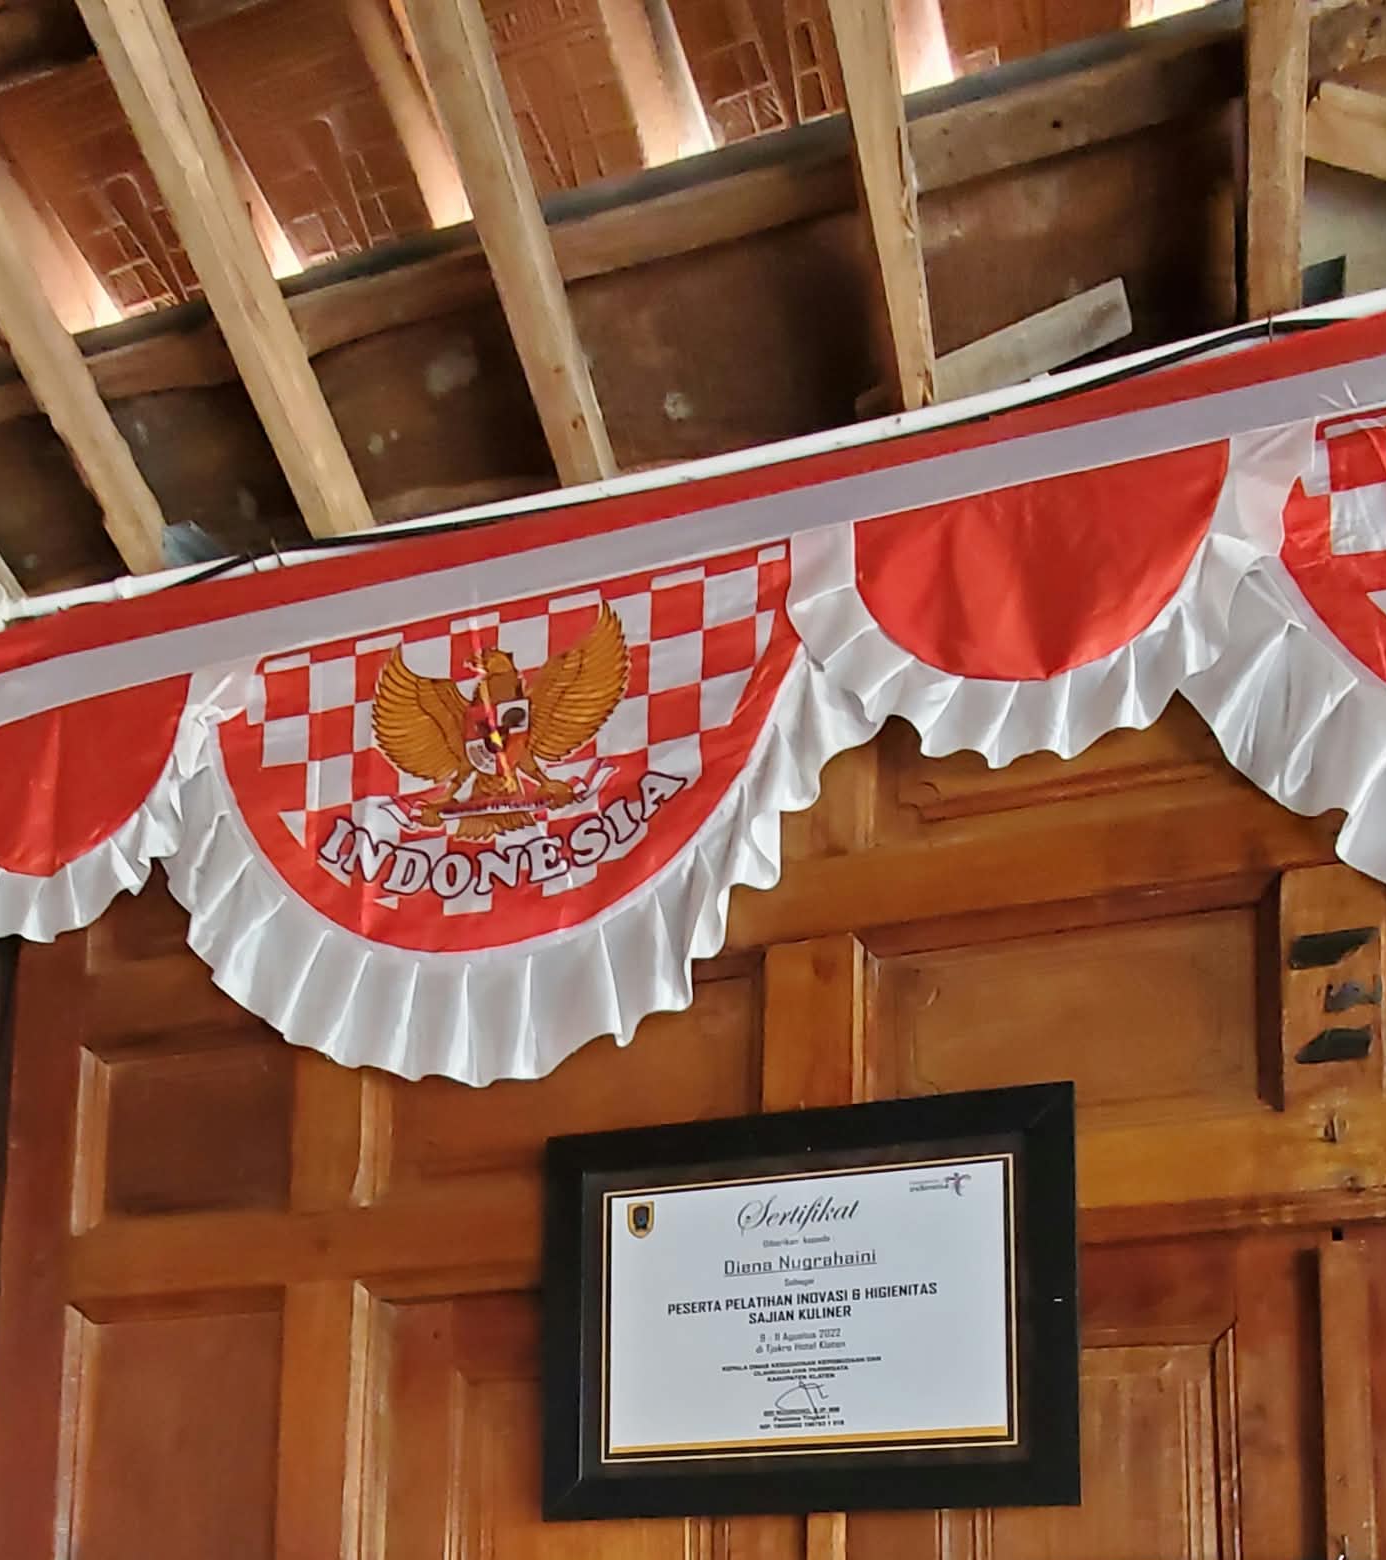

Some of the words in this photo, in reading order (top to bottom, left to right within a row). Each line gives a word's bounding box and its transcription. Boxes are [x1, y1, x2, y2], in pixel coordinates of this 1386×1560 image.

[319, 771, 688, 899] INDONESIA
[737, 1195, 860, 1236] Sertifikat
[779, 1249, 877, 1271] Nugrahaini
[667, 1301, 722, 1315] PESERTA
[725, 1295, 793, 1311] PELATIHAN
[797, 1289, 848, 1305] INOVASI
[865, 1282, 938, 1300] HIGIENITAS
[748, 1309, 794, 1325] SAJIAN
[798, 1305, 852, 1320] KULINER
